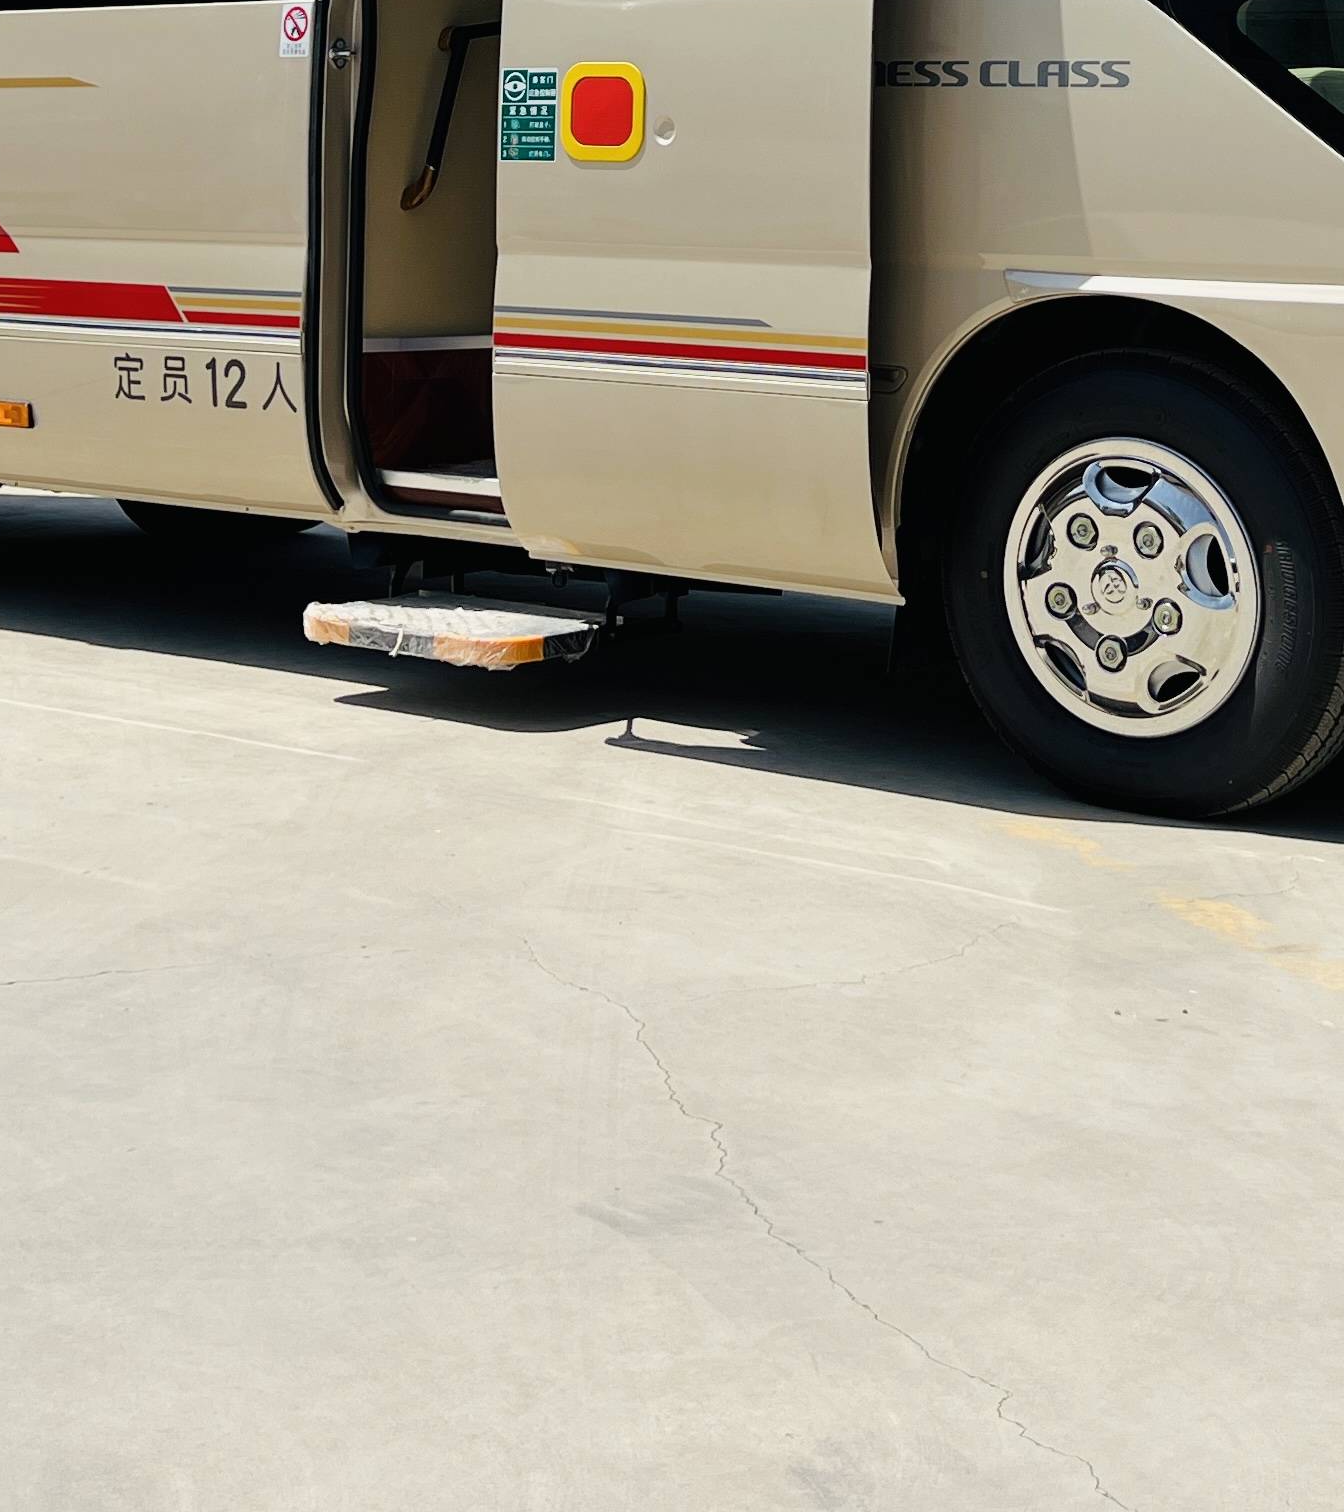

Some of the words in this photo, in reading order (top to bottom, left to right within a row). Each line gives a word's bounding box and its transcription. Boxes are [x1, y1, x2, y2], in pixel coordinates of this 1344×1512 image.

[979, 60, 1131, 88] CLASS
[114, 352, 297, 413] 定员12人
